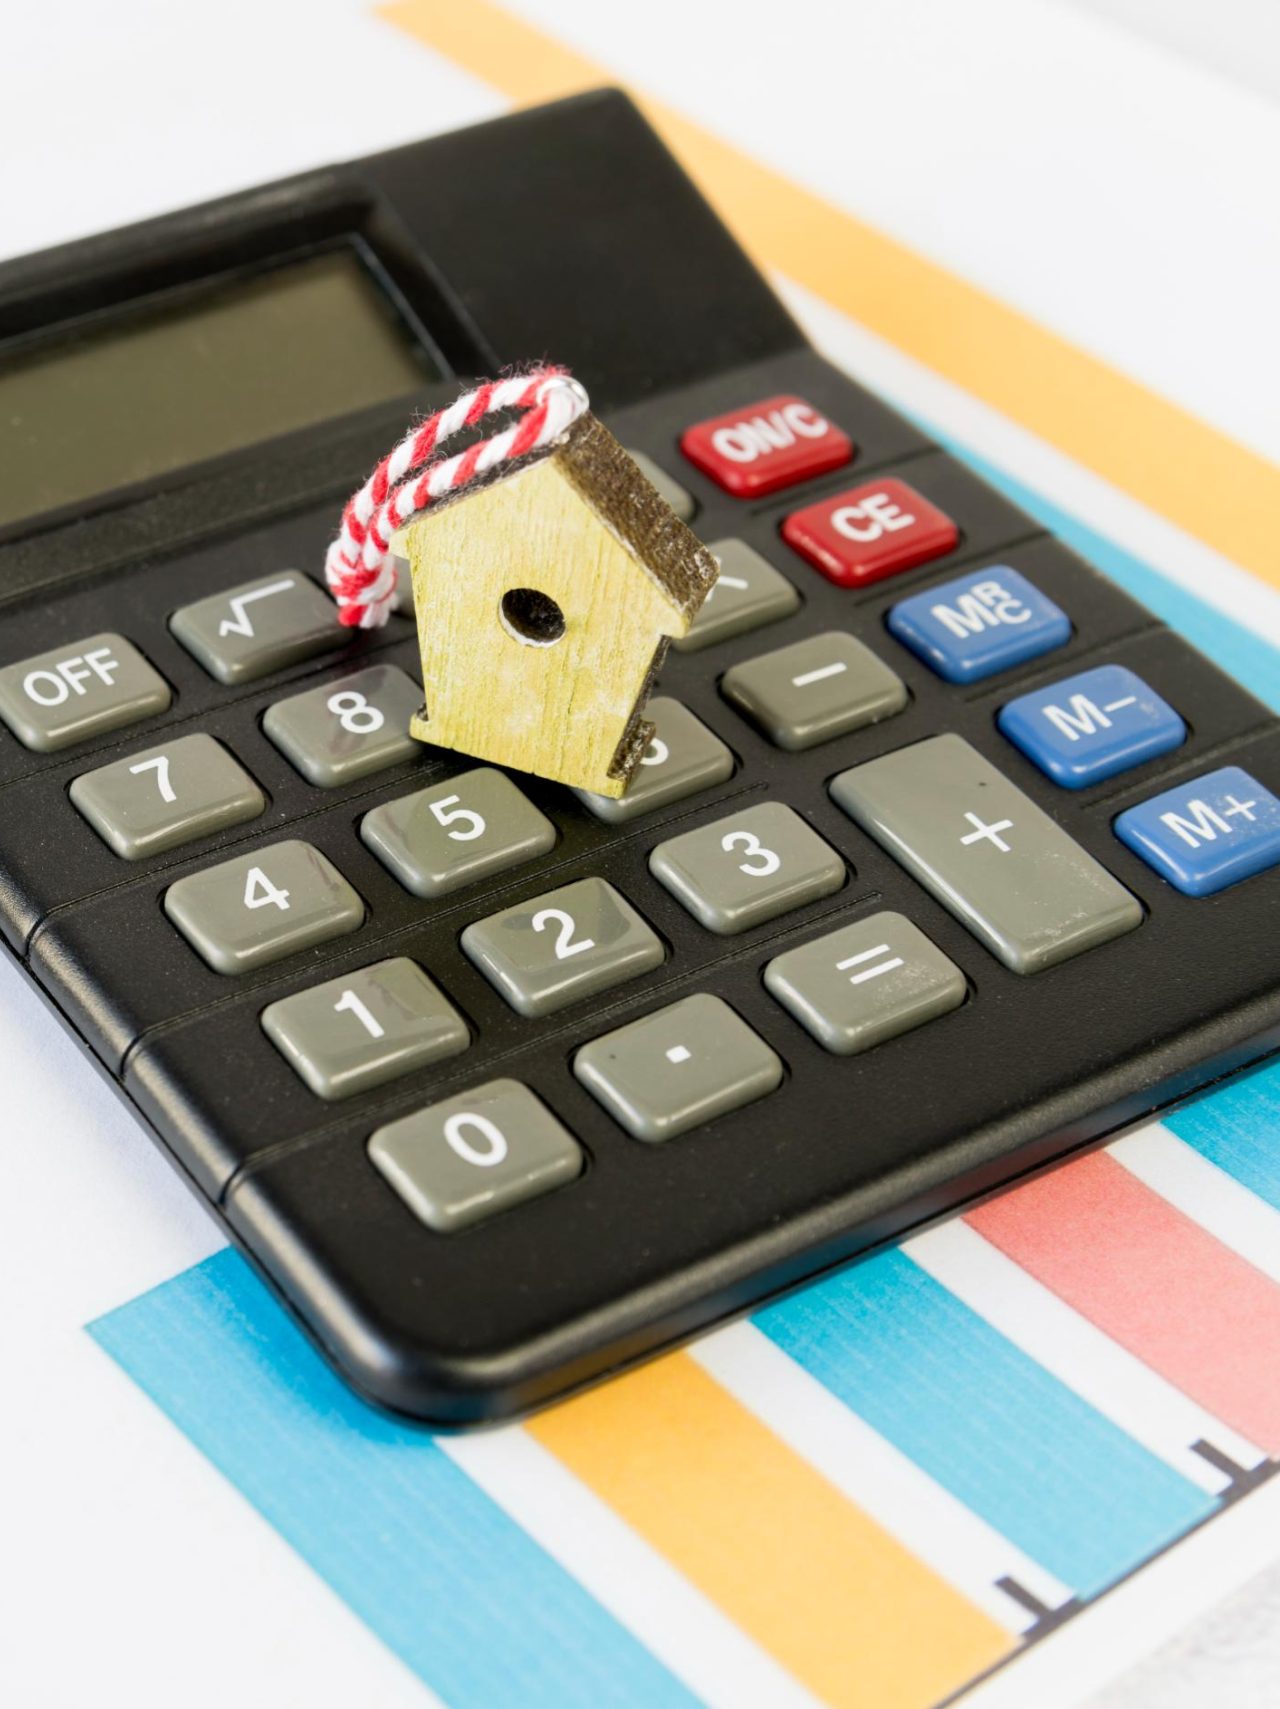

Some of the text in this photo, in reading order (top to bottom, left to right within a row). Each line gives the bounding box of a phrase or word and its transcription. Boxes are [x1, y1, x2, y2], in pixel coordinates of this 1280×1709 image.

[711, 400, 830, 464] ON/C
[829, 492, 917, 544] CE
[23, 647, 119, 706] OFF
[327, 691, 384, 734] 8
[129, 755, 177, 803] 7
[429, 794, 486, 841] 5
[1158, 793, 1260, 850] M+
[721, 831, 781, 877] 3
[243, 866, 290, 911] 4
[531, 908, 595, 960] 2
[334, 990, 385, 1038] 1
[444, 1112, 507, 1166] 0
